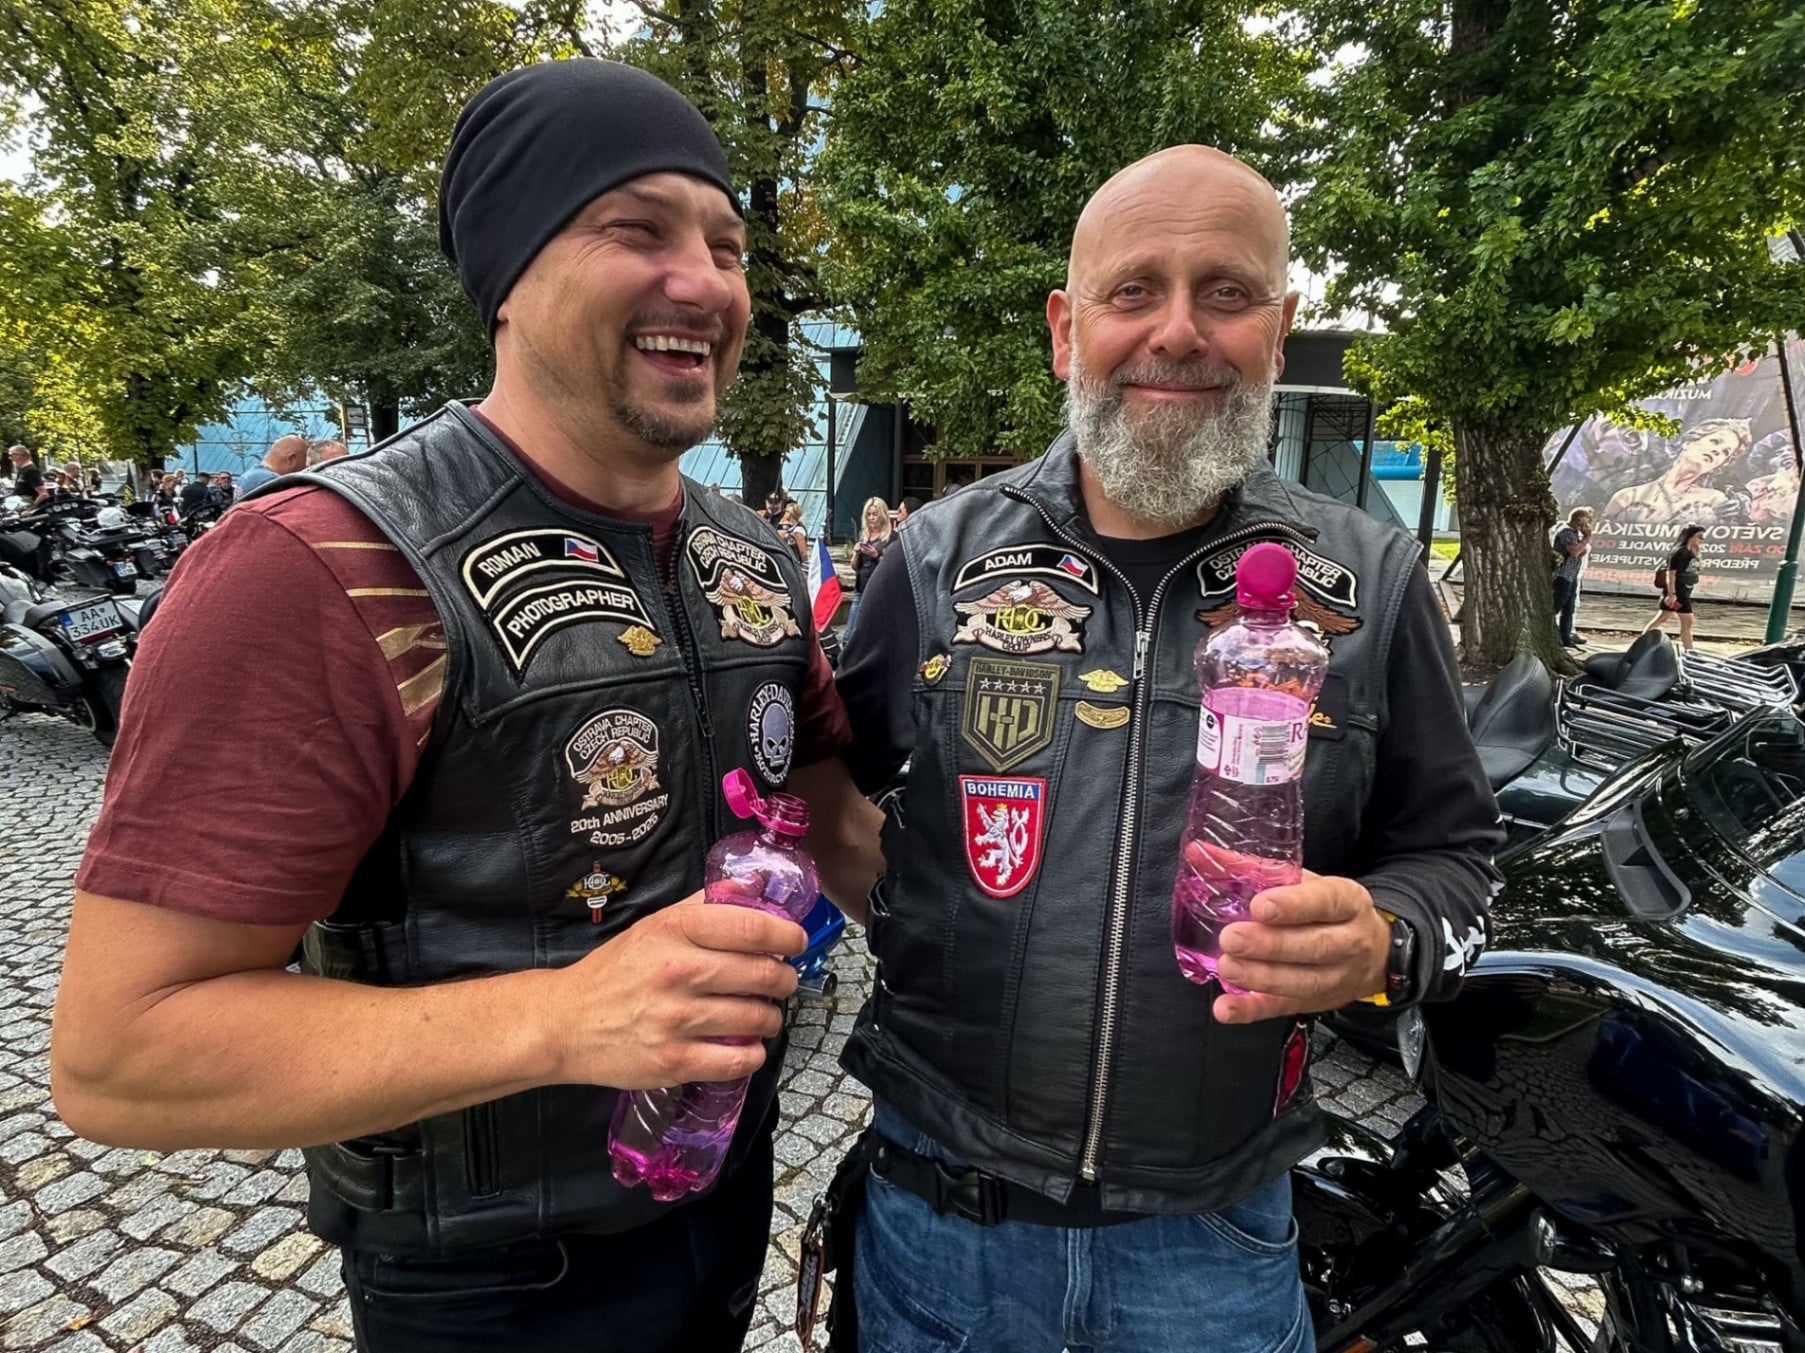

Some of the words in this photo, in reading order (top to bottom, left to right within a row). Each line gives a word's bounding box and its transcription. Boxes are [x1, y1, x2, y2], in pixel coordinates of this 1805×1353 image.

[478, 542, 542, 578] ROMAN
[716, 536, 767, 562] CHAPTER
[985, 553, 1032, 571] ADAM
[70, 615, 120, 638] 334UK
[80, 608, 101, 622] AA
[507, 590, 635, 639] PHOTOGRAPHER
[985, 627, 1014, 643] HARLEY
[573, 718, 612, 752] OSTRAVA
[615, 715, 653, 732] CHAPTER
[580, 732, 610, 760] CZECH
[611, 727, 651, 744] REPUBLIC
[967, 783, 1035, 799] BOHEMIA
[570, 816, 600, 833] 20th
[603, 793, 669, 826] ANNIVERSARY
